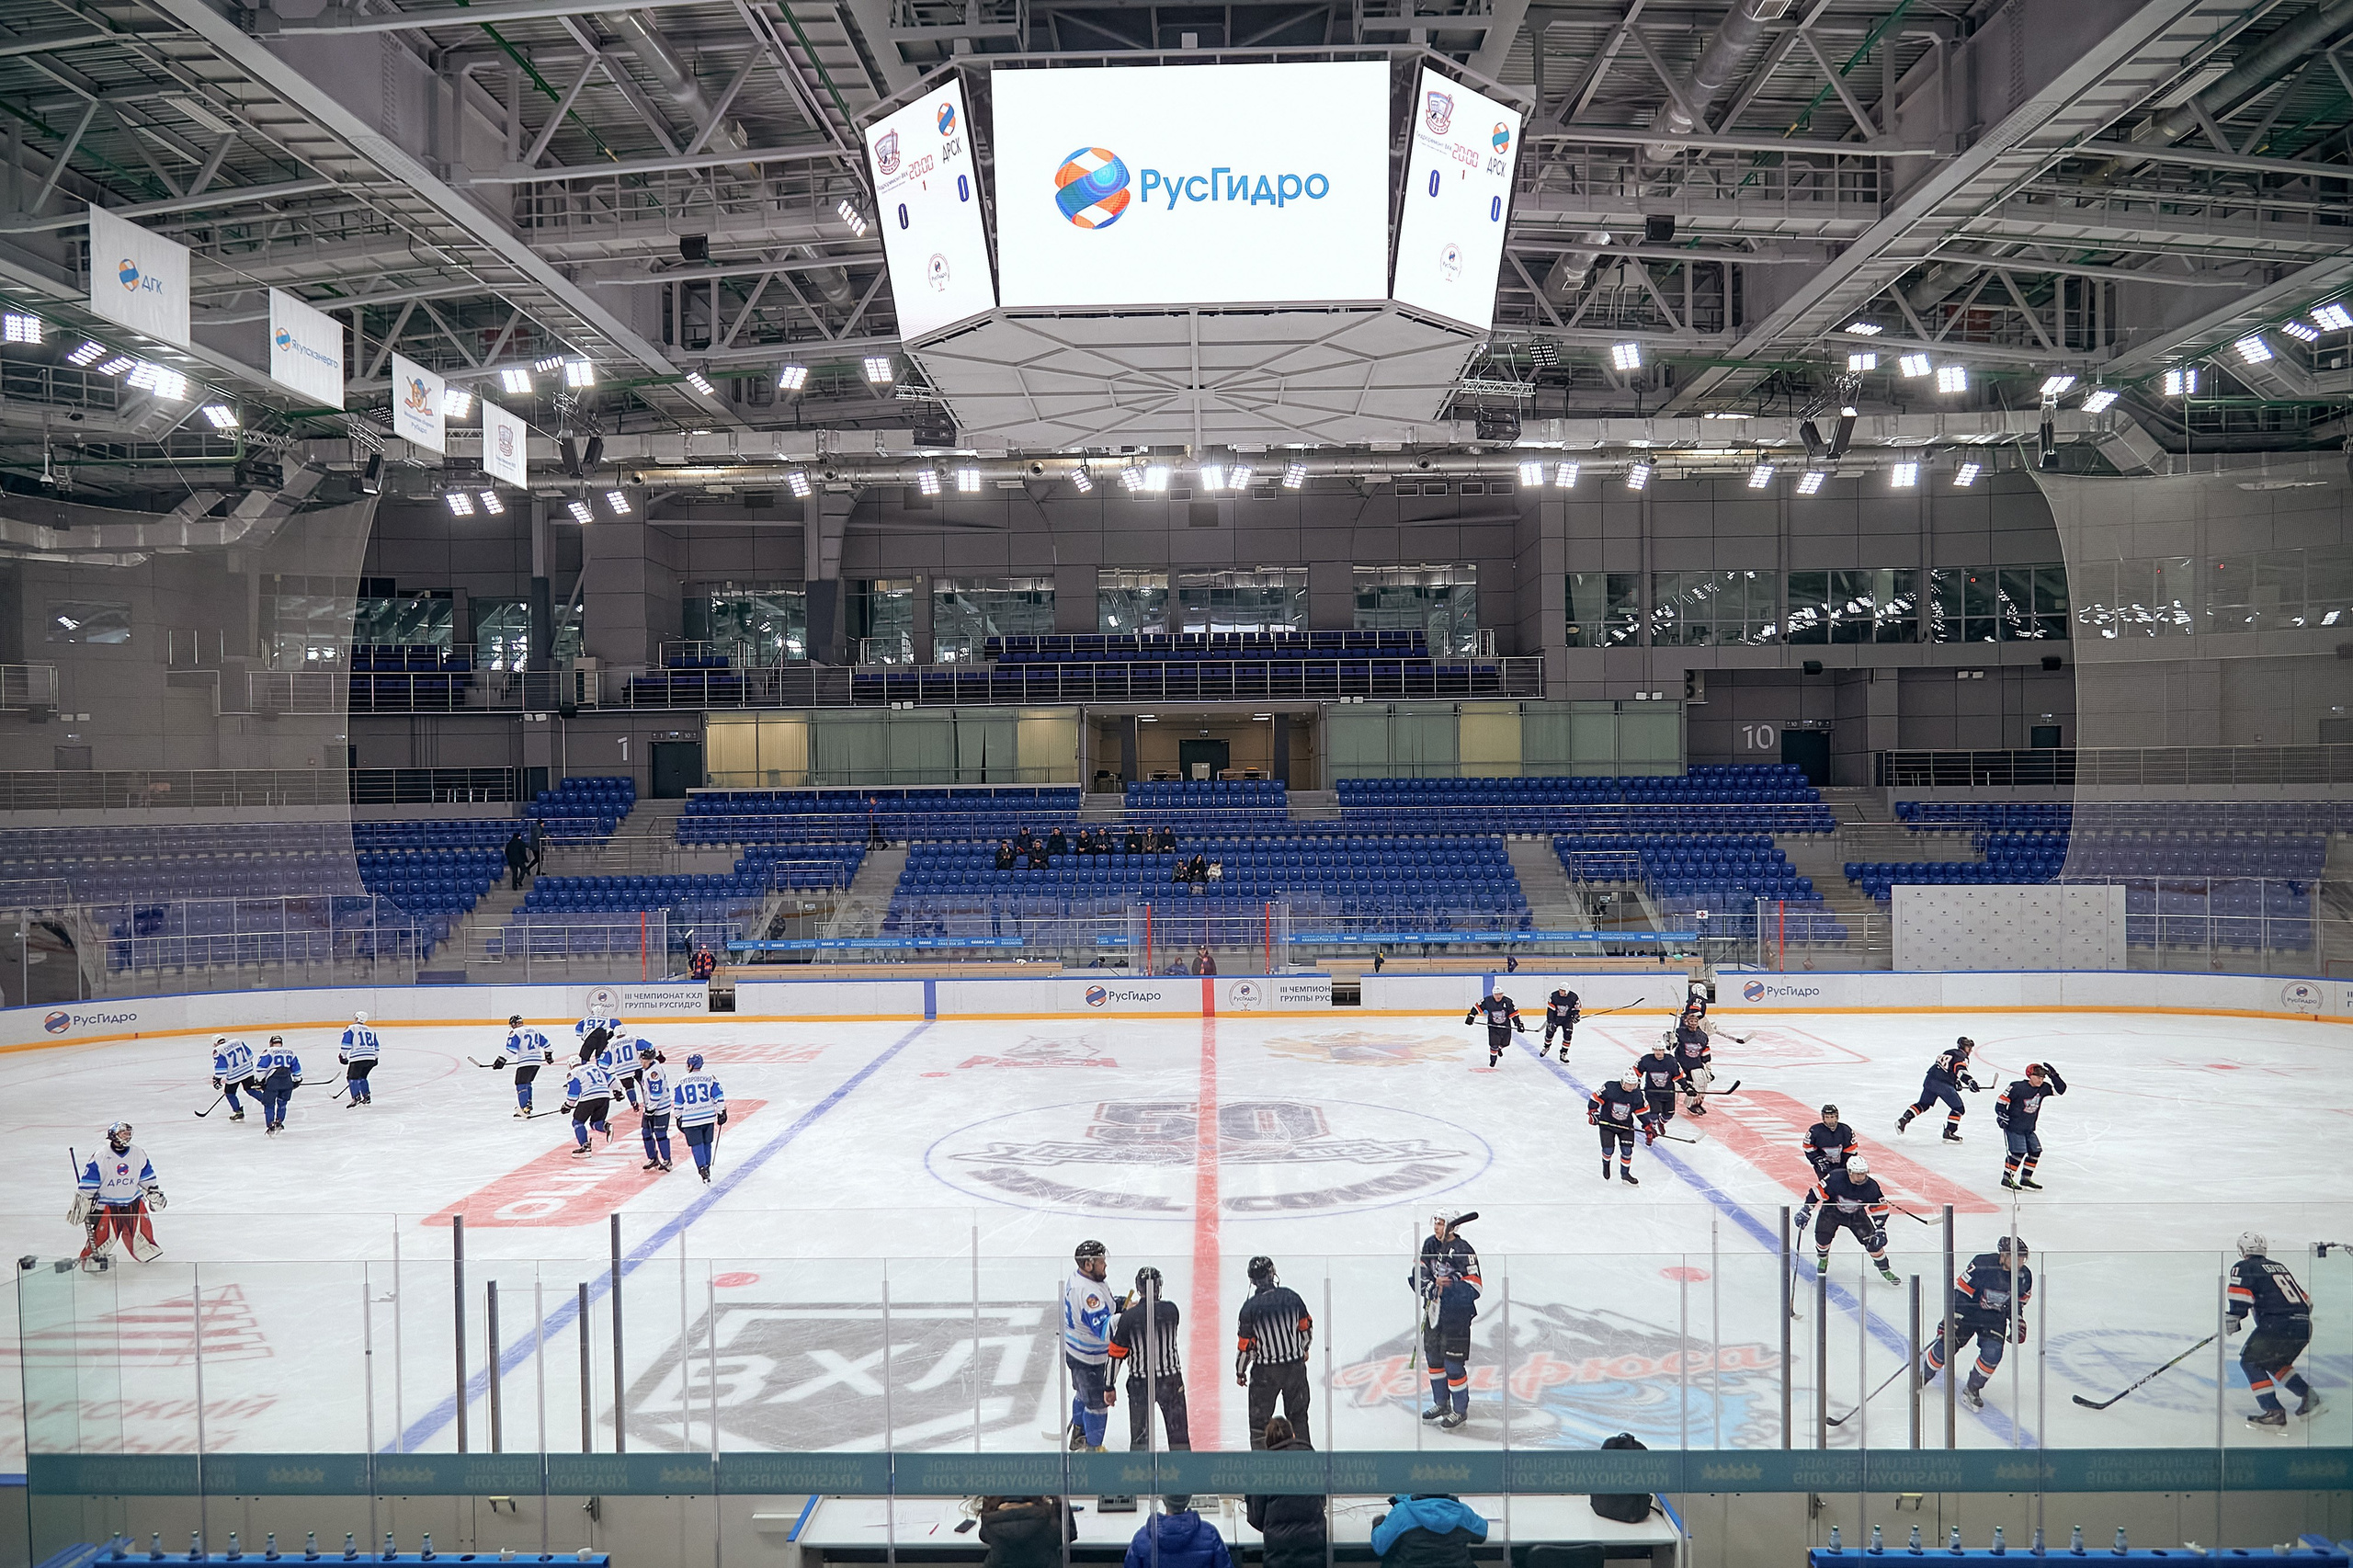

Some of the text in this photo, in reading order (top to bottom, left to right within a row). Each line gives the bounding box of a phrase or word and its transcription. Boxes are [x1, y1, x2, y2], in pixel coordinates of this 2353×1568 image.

[957, 174, 970, 202] 0
[1141, 167, 1330, 210] РусГидро
[1428, 169, 1440, 198] 0
[898, 202, 909, 230] 0
[1491, 195, 1502, 222] 0
[142, 275, 163, 295] ДГК
[1742, 724, 1775, 750] 10
[617, 736, 628, 761] 1
[634, 992, 684, 1000] ЧЕМПИОНАТ
[1108, 990, 1162, 1002] РусГидро
[1767, 985, 1820, 997] РусГидро
[659, 1001, 701, 1009] РУСГИДРО
[74, 1013, 138, 1027] РусГидро
[358, 1031, 375, 1047] 18
[227, 1046, 247, 1068] 77
[616, 1044, 634, 1064] 10
[685, 1083, 709, 1105] 83
[1086, 1101, 1332, 1142] 50
[632, 1334, 1035, 1415] ВХЛ
